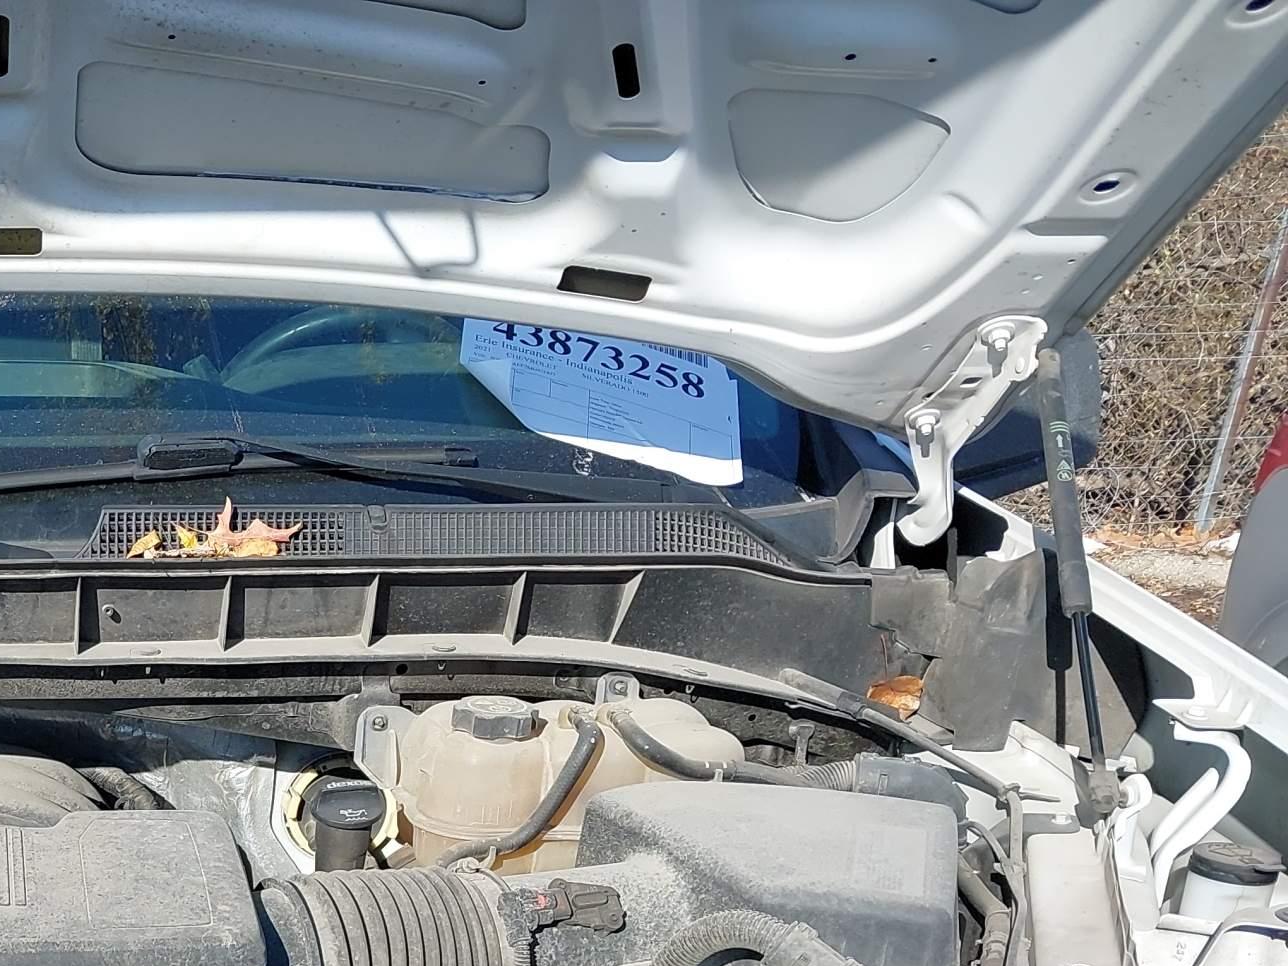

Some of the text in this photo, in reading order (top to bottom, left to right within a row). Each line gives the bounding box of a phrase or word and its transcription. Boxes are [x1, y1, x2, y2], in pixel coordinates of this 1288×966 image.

[475, 334, 497, 346] Erie
[501, 340, 554, 361] Insurance
[566, 358, 633, 385] Indianapolis
[493, 321, 705, 398] 43873258
